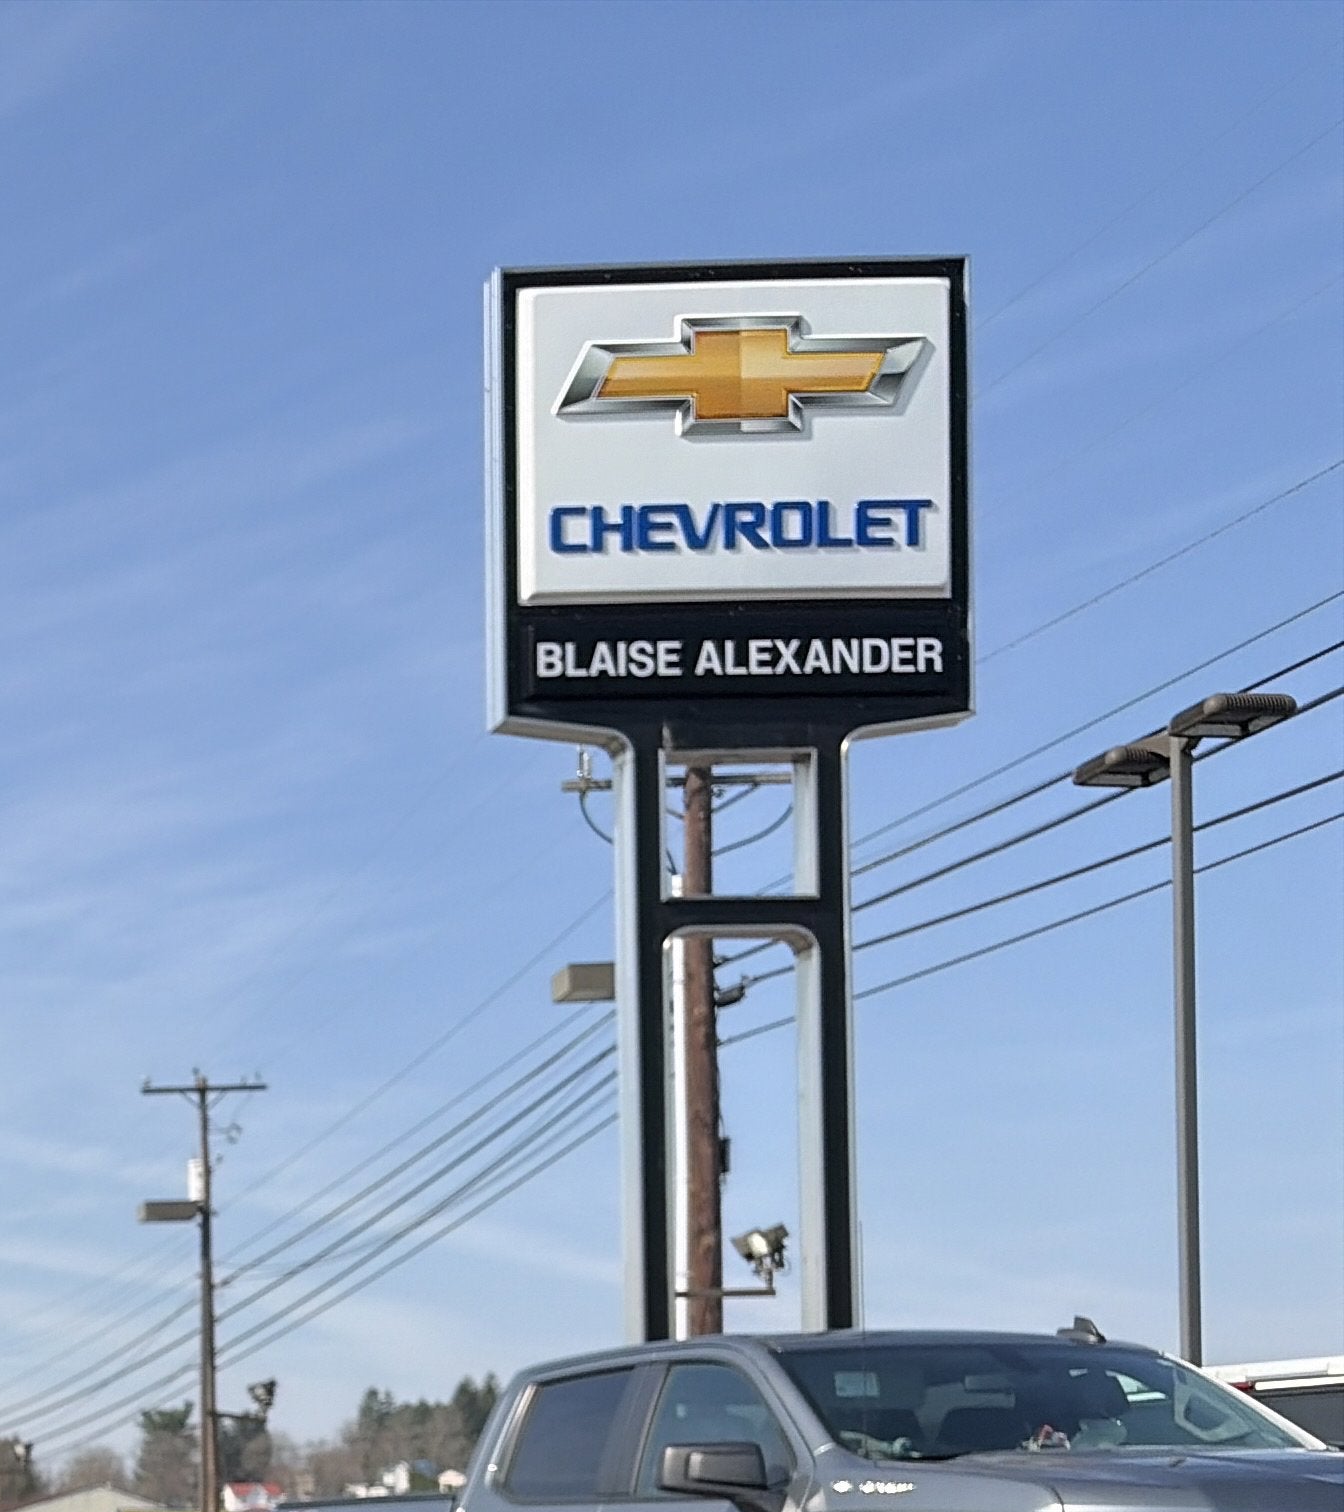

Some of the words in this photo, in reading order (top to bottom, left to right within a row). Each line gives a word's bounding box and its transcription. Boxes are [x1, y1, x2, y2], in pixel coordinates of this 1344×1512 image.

[550, 499, 933, 553] CHEVROLET
[536, 640, 682, 677] BLAISE
[694, 637, 943, 675] ALEXANDER
